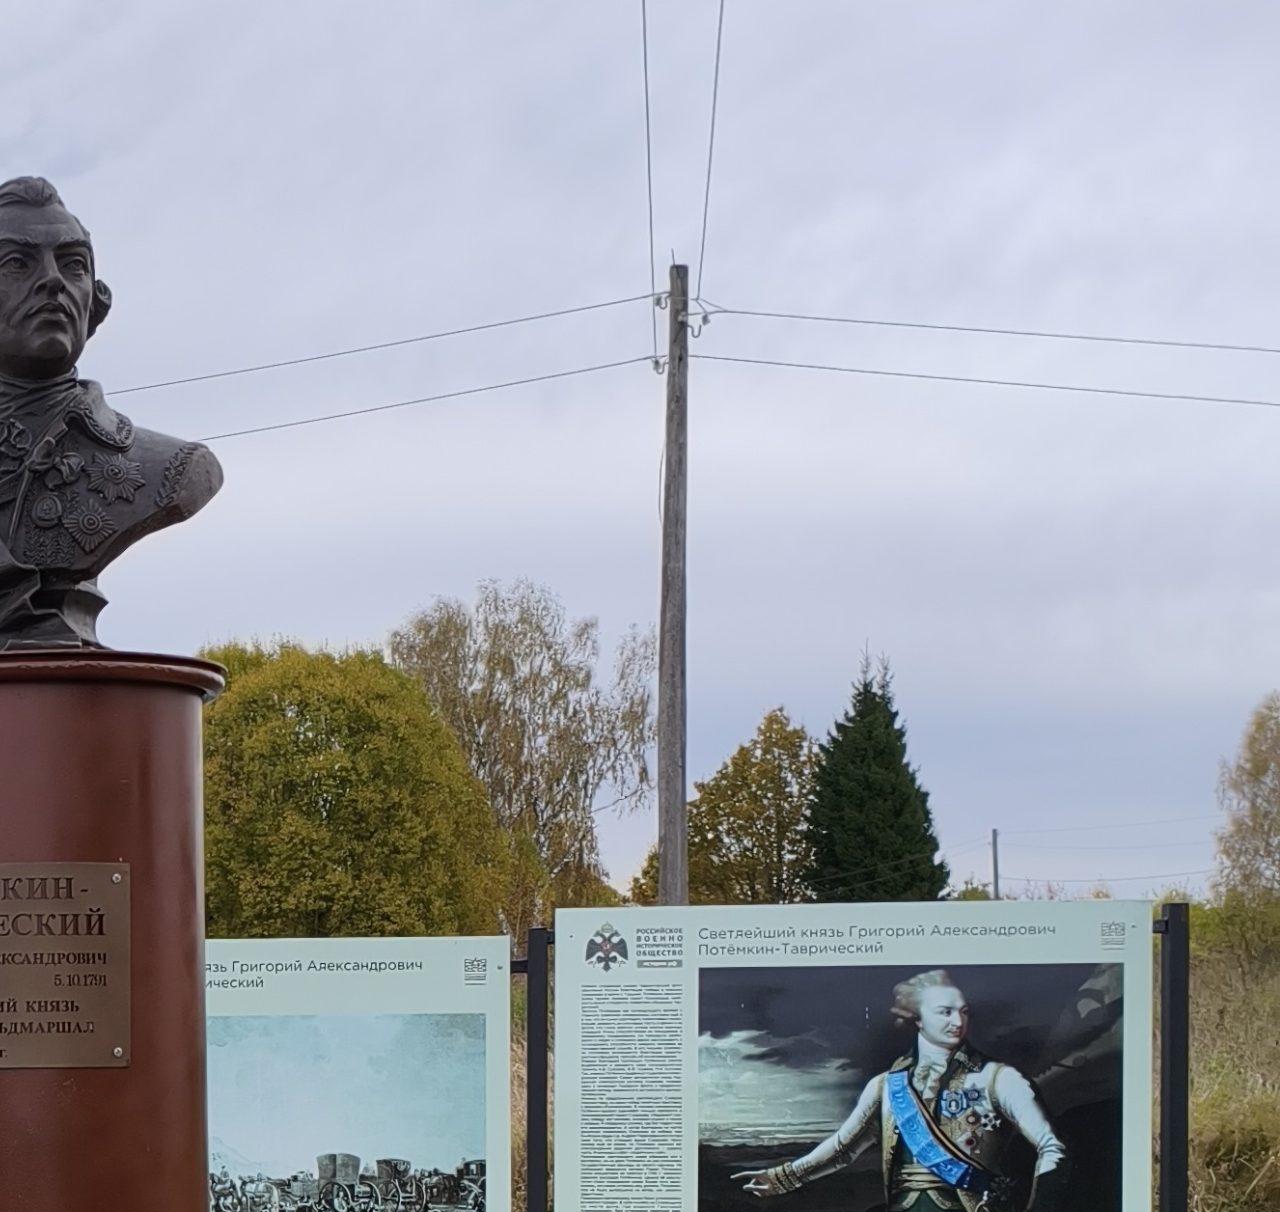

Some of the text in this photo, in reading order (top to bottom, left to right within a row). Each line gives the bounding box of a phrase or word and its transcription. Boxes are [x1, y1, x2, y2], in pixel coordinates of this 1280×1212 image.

[698, 924, 1057, 940] Светлейший князь Григорий Александрович
[636, 950, 683, 958] ОБЩЕСТВО
[698, 941, 884, 957] Потёмкин-Таврический
[205, 958, 423, 974] язь Григорий Александрович
[25, 1000, 80, 1013] КНЯЗЬ
